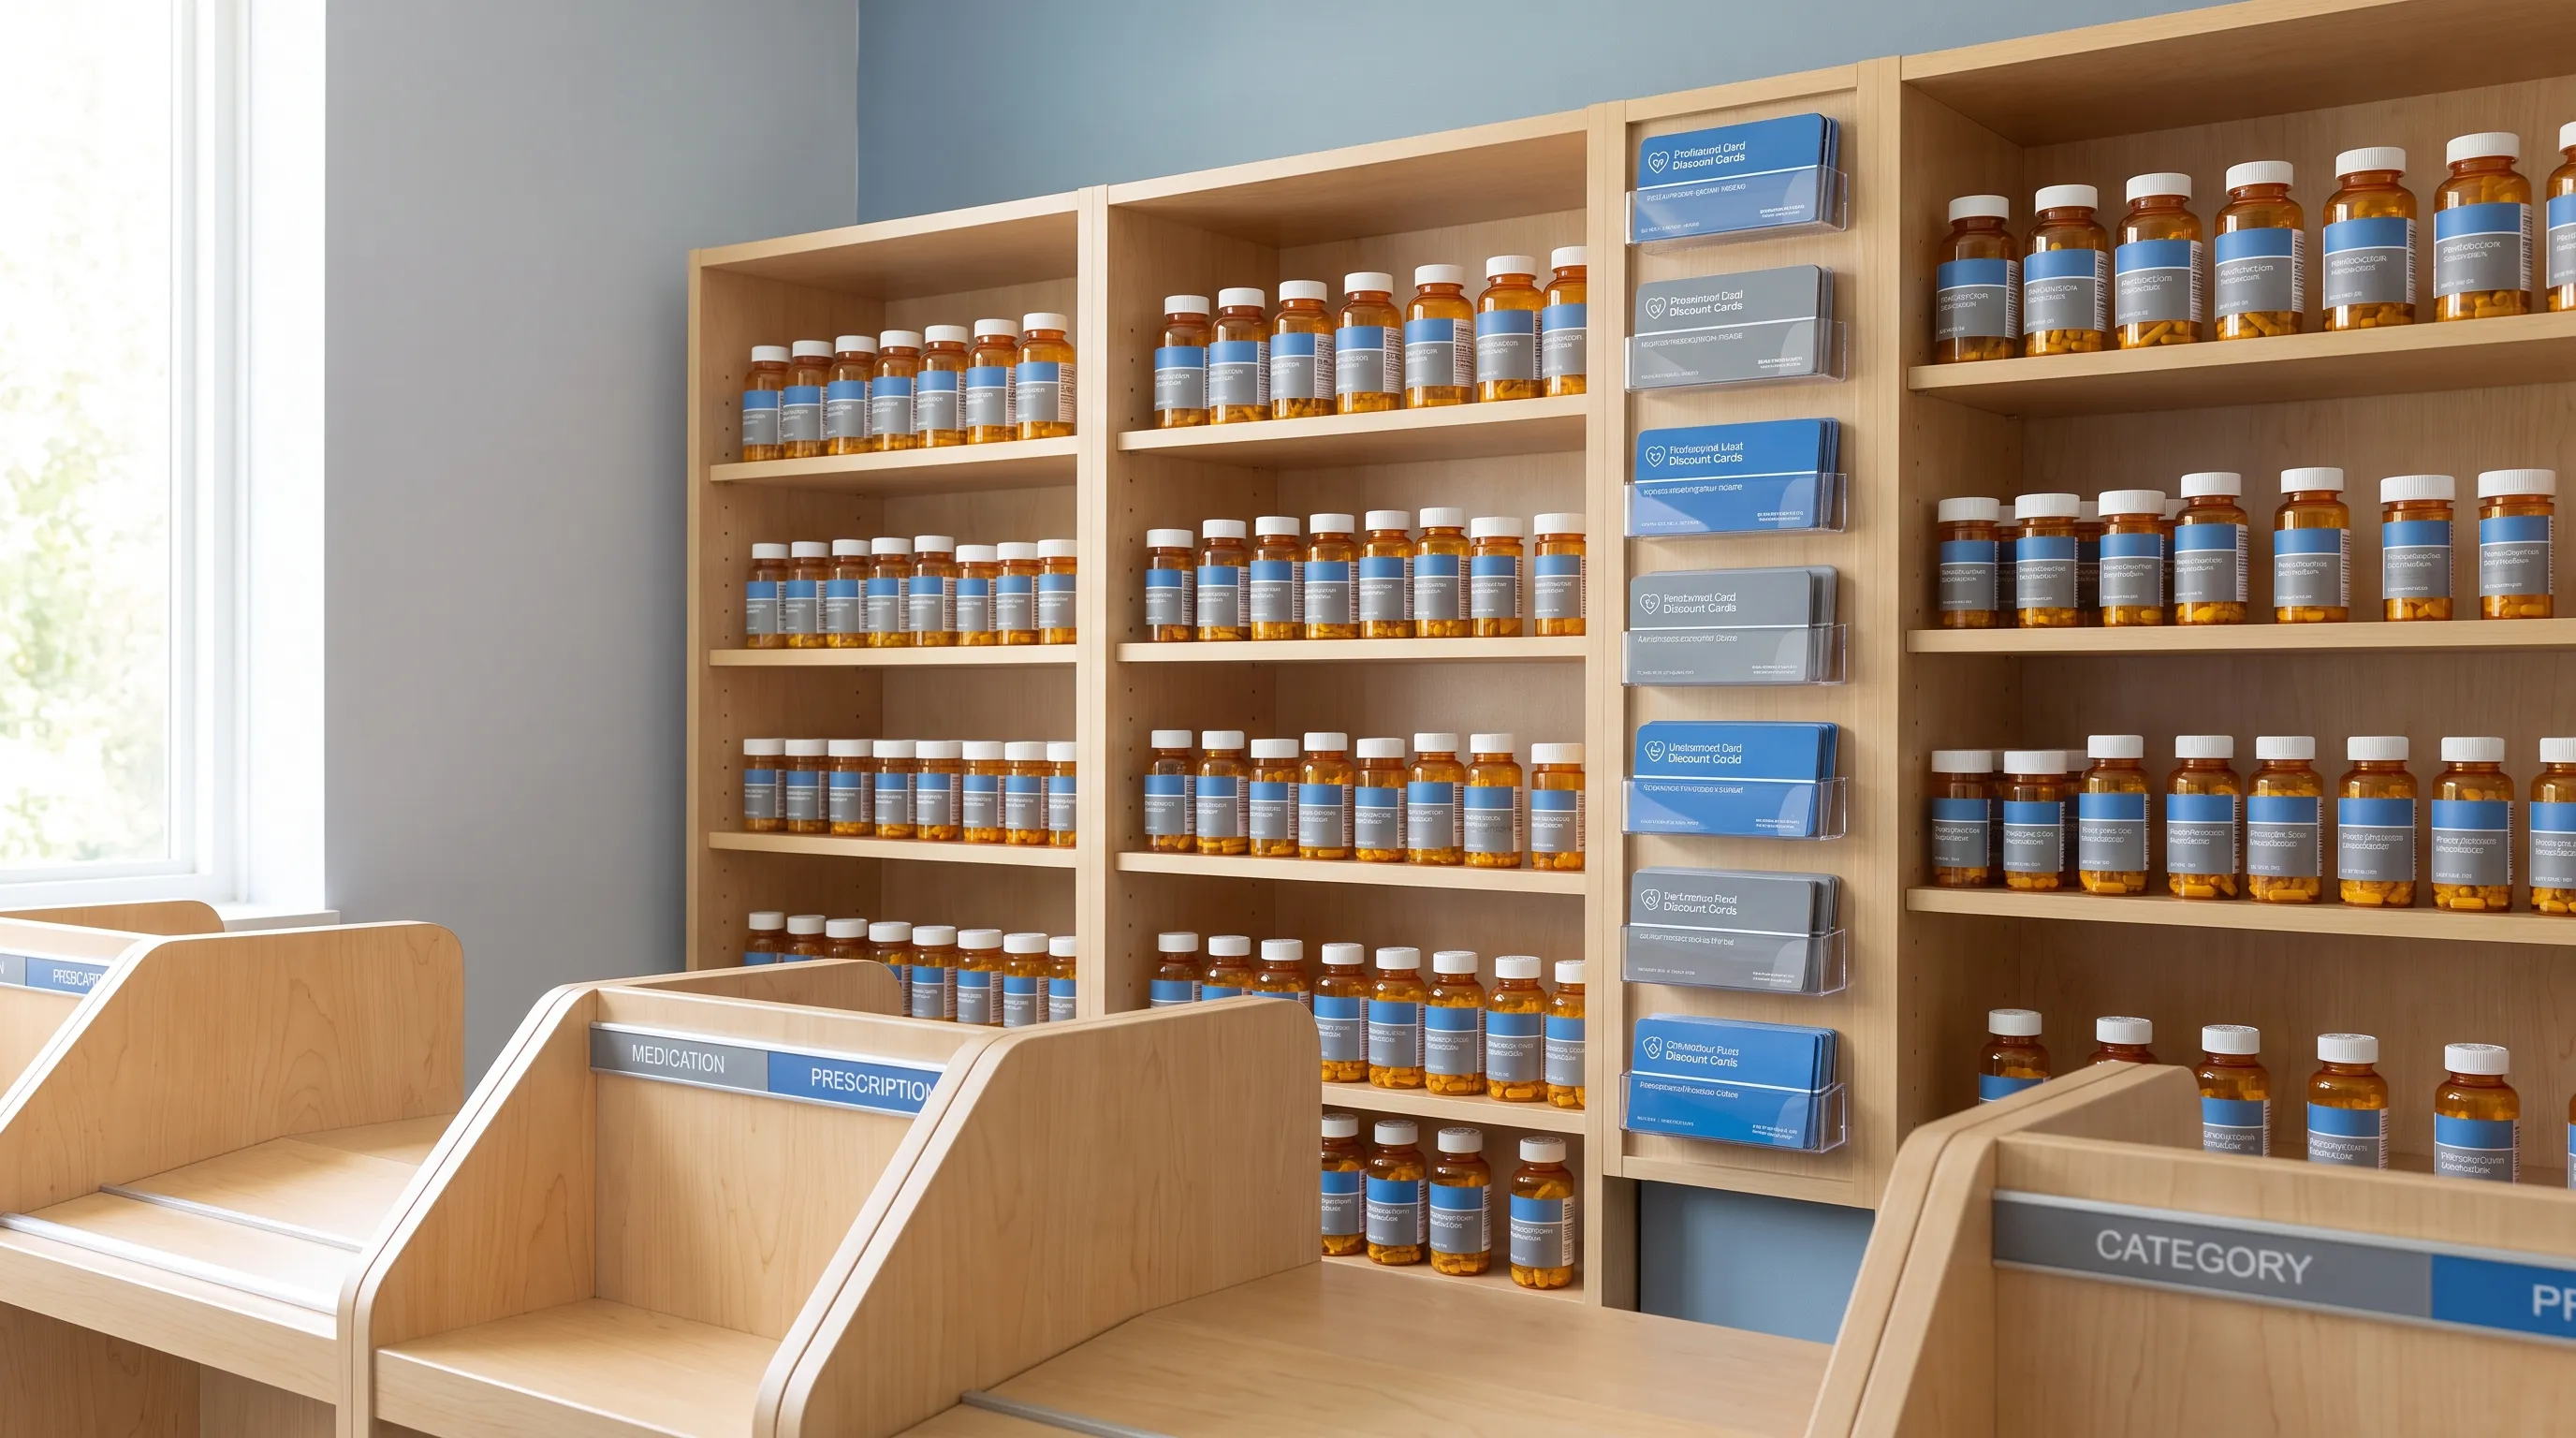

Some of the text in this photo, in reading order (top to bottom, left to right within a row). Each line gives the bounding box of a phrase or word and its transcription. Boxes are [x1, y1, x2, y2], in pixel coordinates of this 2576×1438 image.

[1714, 301, 1743, 313] Cards
[1669, 452, 1743, 466] Discount Cards
[1663, 603, 1705, 614] Discount
[1663, 902, 1706, 914] Discount
[632, 1044, 725, 1074] MEDICATION
[1665, 1050, 1708, 1064] Discount
[2096, 1228, 2312, 1284] CATEGORY
